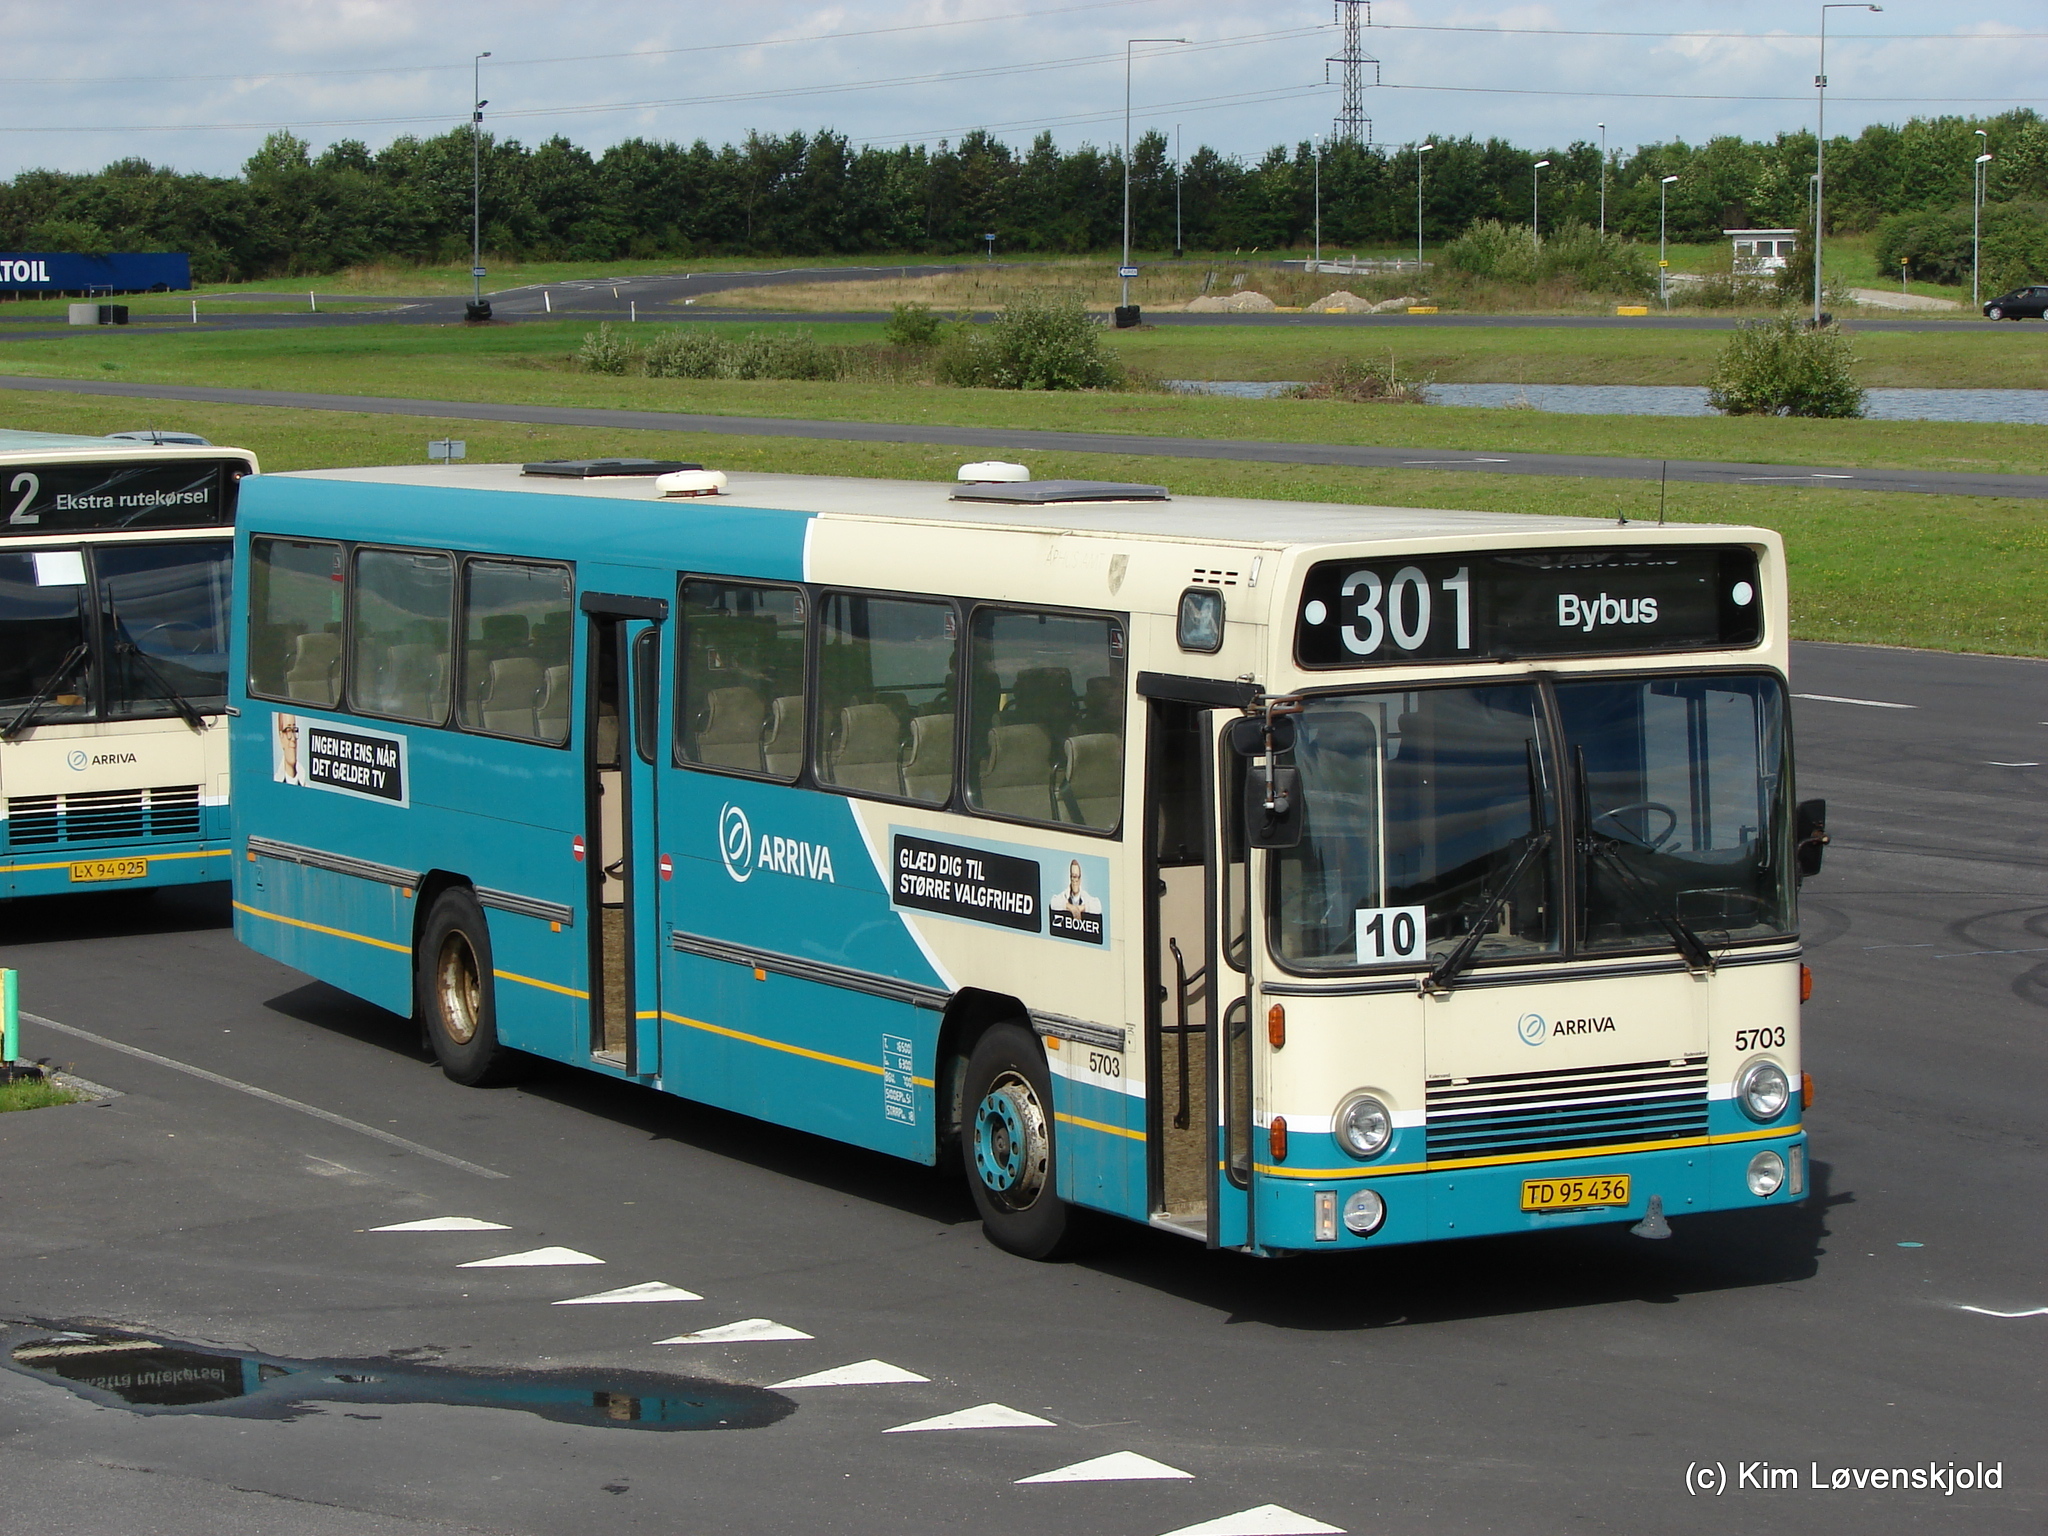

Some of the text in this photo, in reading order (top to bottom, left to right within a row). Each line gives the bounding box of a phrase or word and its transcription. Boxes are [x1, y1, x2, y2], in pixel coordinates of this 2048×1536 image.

[0, 260, 50, 282] TOIL
[9, 472, 40, 525] 2
[56, 487, 209, 511] Ekstra rutekørsel
[1340, 565, 1471, 656] 301
[1558, 592, 1659, 632] Bybus
[91, 752, 137, 766] ARRIVA
[311, 734, 397, 769] INGEN ER ENS, NÅR
[312, 757, 386, 789] DET GÆLDER TV
[73, 861, 144, 879] LX 94 925
[757, 834, 835, 884] ARRIVA
[899, 848, 985, 881] GLÆD DIG TIL
[899, 873, 1034, 916] STØRRE VALGFRIHED
[1064, 917, 1100, 935] BOXER
[1366, 912, 1416, 958] 10
[1552, 1016, 1616, 1037] ARRIVA
[1735, 1026, 1786, 1052] 5703
[1089, 1052, 1120, 1078] 5703
[1527, 1180, 1625, 1204] TD 95 436
